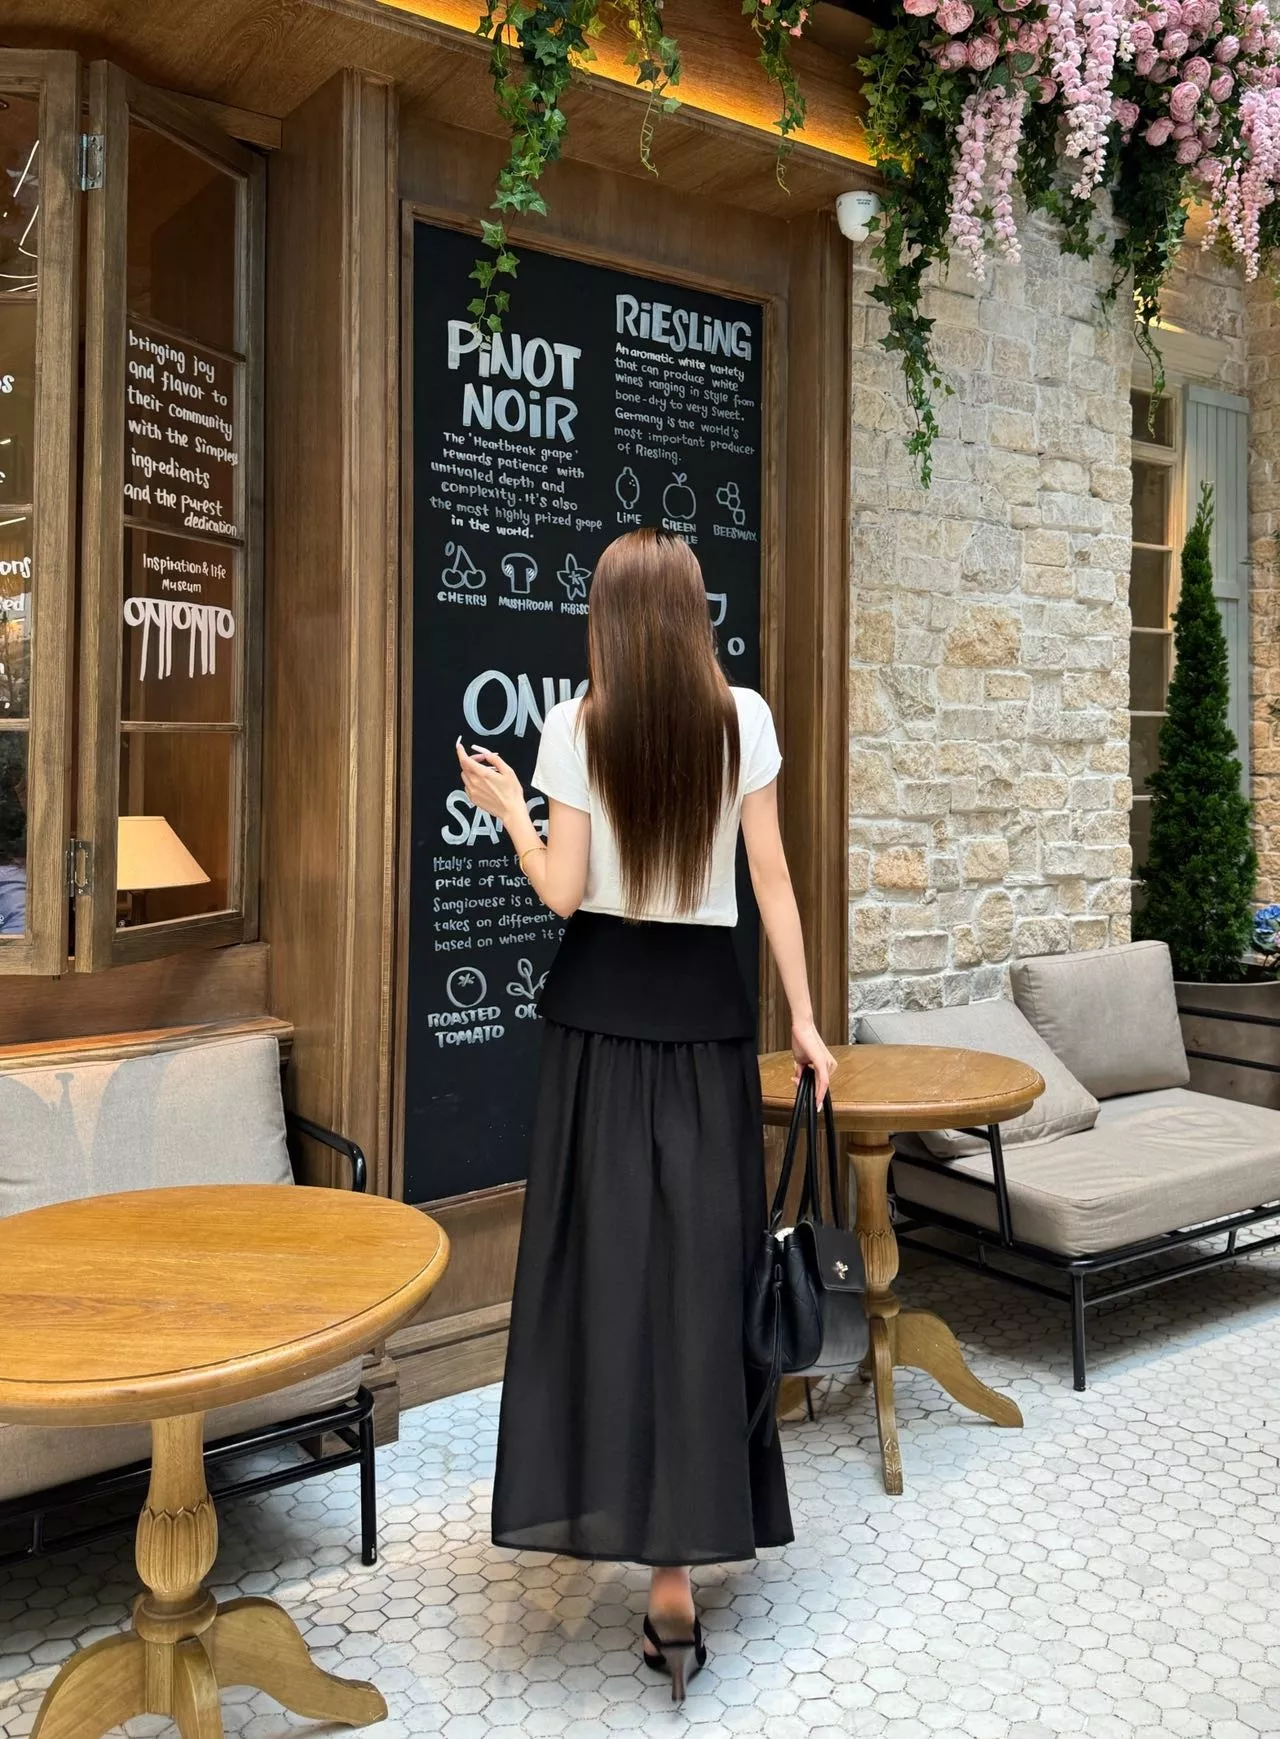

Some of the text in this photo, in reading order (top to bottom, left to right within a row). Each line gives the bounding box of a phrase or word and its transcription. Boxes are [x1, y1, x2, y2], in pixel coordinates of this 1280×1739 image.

[129, 329, 214, 383] bringing joy
[616, 343, 744, 382] An aromatic white variety
[129, 361, 227, 406] and flavor to
[615, 357, 738, 391] that can produce white
[128, 385, 163, 412] their
[615, 373, 642, 387] wines
[649, 380, 685, 399] ranging
[691, 386, 699, 397] in
[734, 395, 754, 408] from
[670, 400, 682, 410] to
[686, 404, 707, 419] very
[128, 420, 161, 440] with
[166, 427, 188, 447] the
[615, 407, 739, 439] Germany is the world's
[444, 432, 465, 445] The
[615, 427, 755, 455] most important producer
[443, 449, 584, 479] rewards patience with
[618, 443, 681, 465] of Riesling.
[132, 448, 210, 489] ingredients
[431, 461, 564, 494] unrivaled depth and
[124, 484, 223, 517] and the purest
[553, 497, 577, 511] also
[185, 512, 237, 537] dedication
[430, 497, 602, 532] the most highly prized grape
[662, 518, 696, 533] GREEN
[451, 515, 534, 539] in the world.
[713, 525, 757, 542] BEESWAX
[143, 553, 201, 575] Inspiration
[202, 562, 208, 577] &
[162, 579, 201, 593] Museum
[437, 591, 486, 607] CHERRY
[499, 596, 553, 612] MUSHROOM
[433, 856, 472, 872] Italy's
[479, 856, 509, 868] most
[435, 877, 471, 890] pride
[479, 875, 494, 888] of
[433, 897, 505, 914] Sangiovese
[511, 895, 520, 907] is
[525, 897, 532, 906] a
[433, 919, 470, 932] takes
[477, 919, 491, 928] on
[498, 911, 555, 928] different
[435, 937, 471, 951] based
[477, 938, 492, 948] on
[499, 932, 536, 944] where
[542, 929, 554, 940] it
[428, 1006, 501, 1028] ROASTED
[435, 1025, 504, 1048] TOMATO
